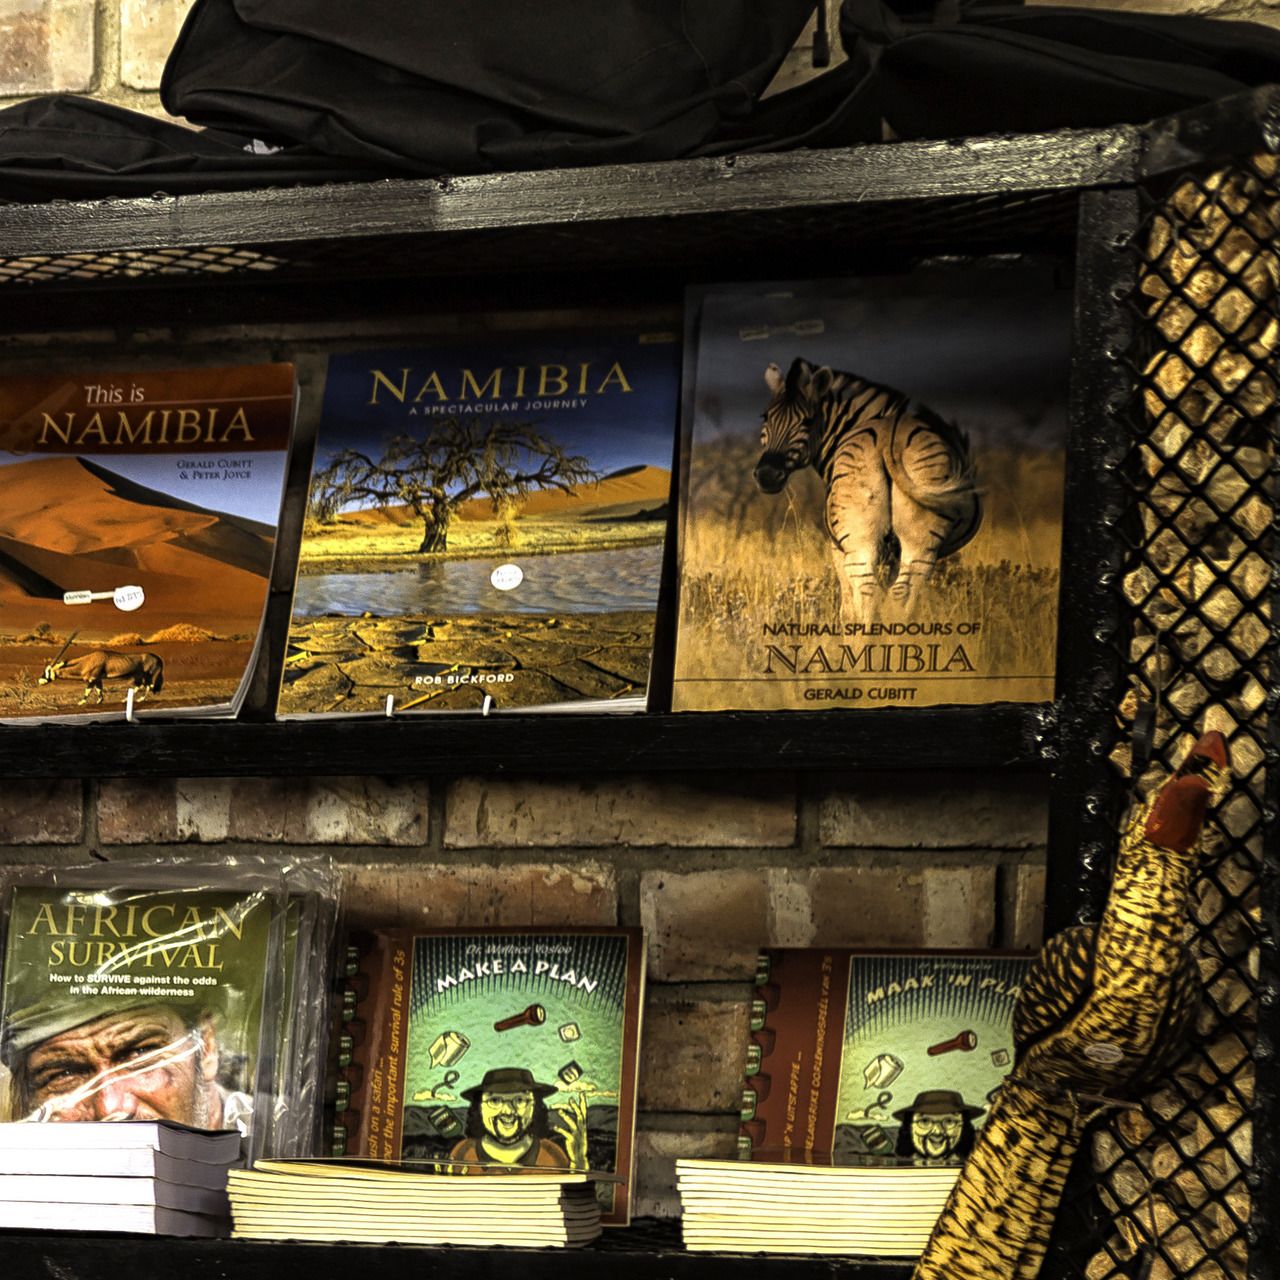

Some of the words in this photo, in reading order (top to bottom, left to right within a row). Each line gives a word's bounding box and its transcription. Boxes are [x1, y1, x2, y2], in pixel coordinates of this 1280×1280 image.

[368, 361, 634, 404] NAMIBIA
[84, 384, 123, 404] This
[130, 384, 145, 402] is
[409, 406, 418, 415] A
[424, 402, 519, 415] SPECTACULAR
[525, 399, 589, 411] JOURNEY
[37, 407, 255, 445] NAMIBIA
[763, 622, 841, 636] NATURAL
[845, 622, 953, 636] SPLENDOURS
[956, 622, 981, 635] OF
[763, 644, 976, 674] NAMIBIA
[415, 676, 442, 685] ROB
[447, 673, 514, 685] BICKFORD
[803, 688, 863, 701] GERALD
[867, 688, 917, 700] CUBITT
[26, 903, 244, 940] AFRICAN
[48, 939, 224, 972] SURVIVAL
[49, 973, 72, 983] How
[73, 974, 85, 983] to
[87, 974, 131, 983] SURVIVE
[133, 975, 171, 986] against
[173, 975, 190, 985] the
[192, 976, 217, 985] odds
[394, 964, 404, 981] of
[437, 959, 504, 993] MAKE
[511, 959, 527, 973] A
[535, 959, 598, 993] PLAN
[70, 985, 80, 995] in
[82, 985, 99, 995] the
[100, 986, 138, 996] African
[139, 986, 195, 997] wilderness
[394, 983, 403, 1007] rule
[867, 974, 935, 1004] MAAK
[980, 978, 1022, 998] PLA
[390, 1007, 401, 1054] survival
[373, 1069, 382, 1101] safari
[388, 1057, 398, 1116] important
[373, 1103, 380, 1114] a
[372, 1115, 379, 1132] on
[385, 1118, 394, 1139] the
